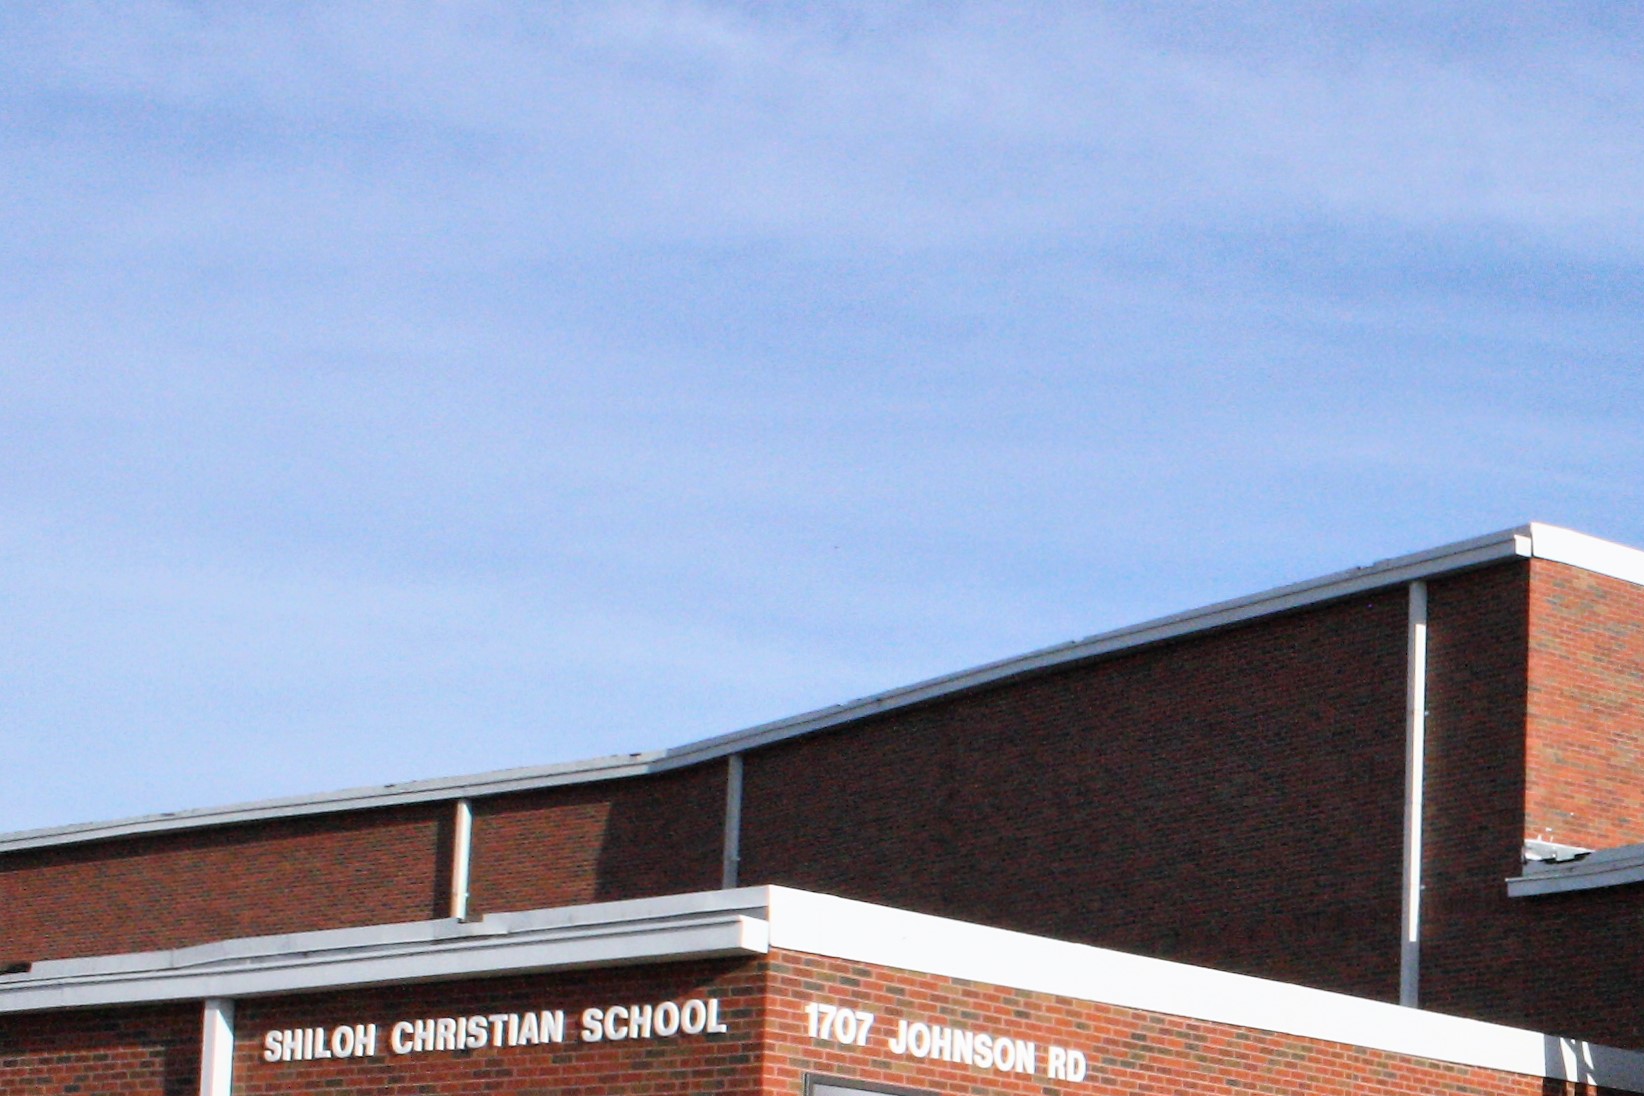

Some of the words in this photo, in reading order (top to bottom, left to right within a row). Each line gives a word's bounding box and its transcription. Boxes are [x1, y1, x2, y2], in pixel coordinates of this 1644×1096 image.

[264, 1024, 376, 1062] SHILOH
[391, 1011, 564, 1054] CHRISTIAN
[581, 999, 727, 1043] SCHOOL
[805, 1002, 874, 1047] 1707
[888, 1020, 1036, 1075] JOHNSON
[1048, 1046, 1087, 1083] RD
